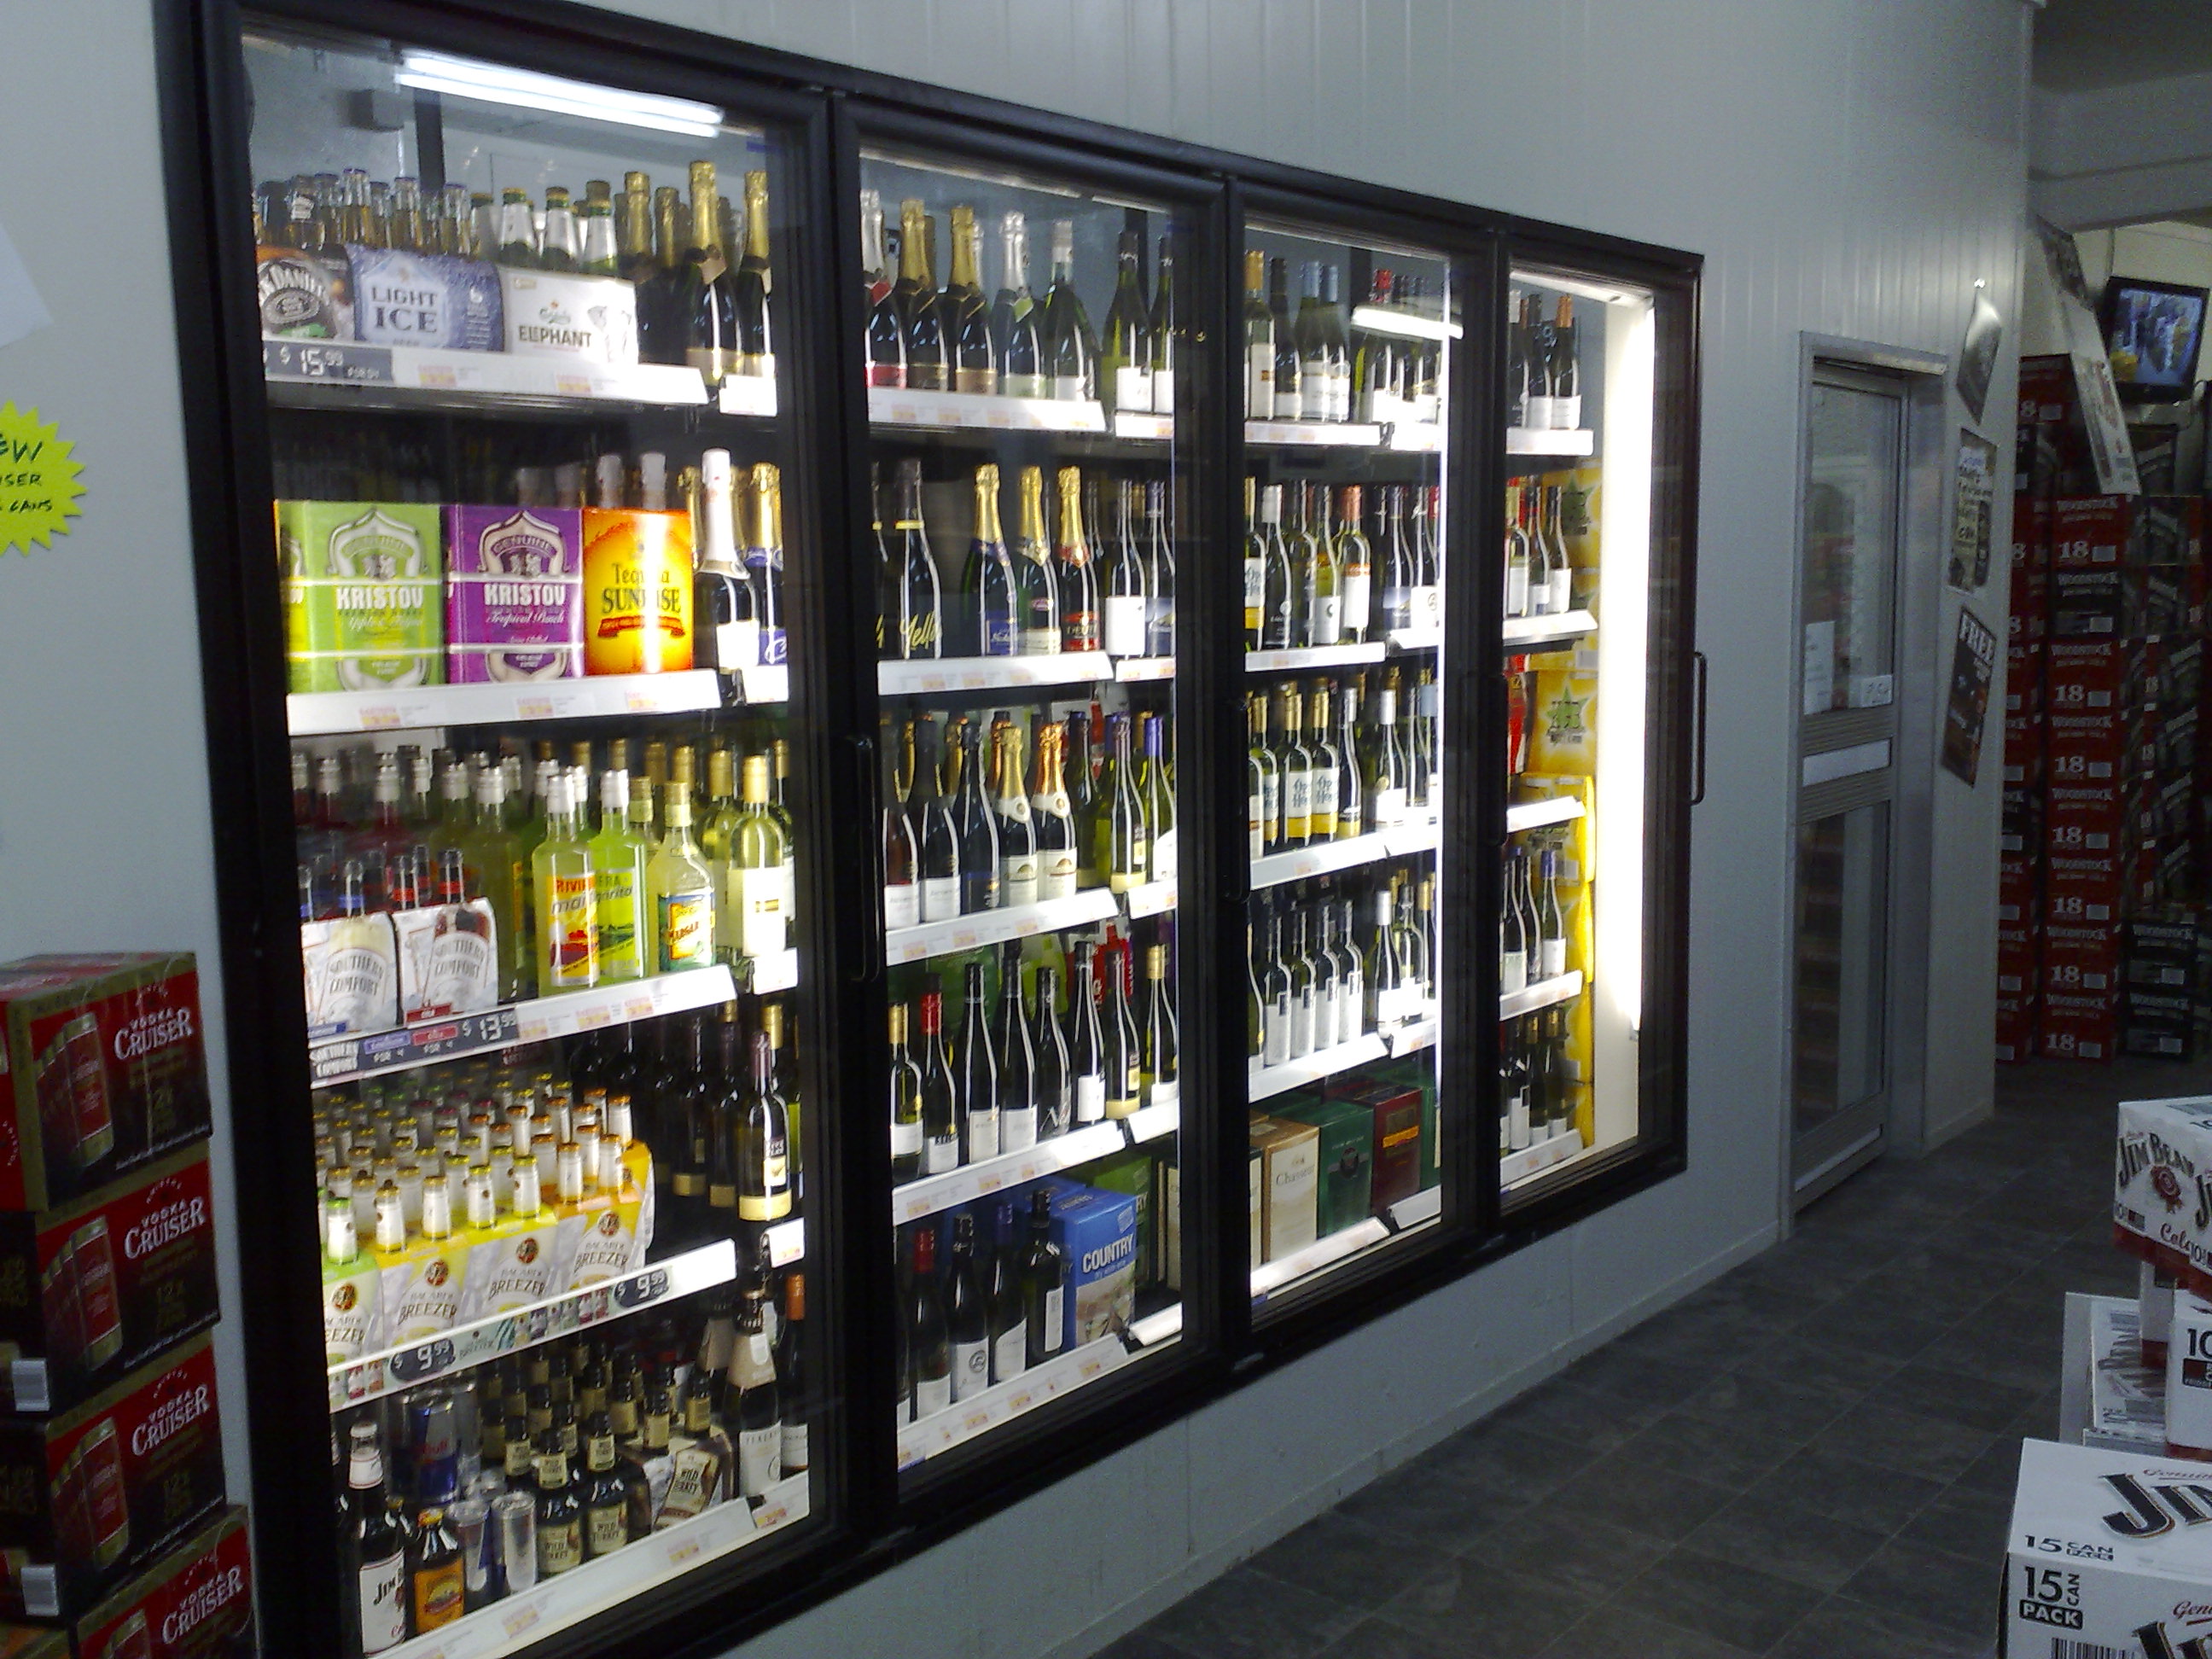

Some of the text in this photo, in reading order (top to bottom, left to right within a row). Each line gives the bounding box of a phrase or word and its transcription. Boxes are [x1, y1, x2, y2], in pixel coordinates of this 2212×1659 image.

[371, 286, 438, 306] LIGHT
[375, 307, 438, 333] ICE
[519, 325, 591, 347] ELEPHANT
[0, 434, 43, 463] EW
[2059, 541, 2089, 559] 18
[336, 587, 424, 609] KRISTOV
[484, 584, 566, 606] KRISTOV
[602, 587, 681, 614] SUNISE
[2056, 684, 2085, 702] 18
[2055, 755, 2085, 773] 18
[2052, 825, 2082, 844] 18
[2055, 896, 2082, 914] 18
[2052, 965, 2080, 982] 18
[130, 1008, 172, 1029] VODKA
[114, 1007, 193, 1060] CRUISER
[2048, 1033, 2076, 1051] 18
[2119, 1132, 2194, 1188] JIM BEAM
[142, 1199, 187, 1227] VODKA
[125, 1196, 207, 1260] CRUISER
[573, 1250, 629, 1275] BREEZER
[1082, 1233, 1134, 1273] COUNTRY
[487, 1278, 546, 1301] BREEZER
[398, 1302, 458, 1326] BREEZER
[148, 1388, 191, 1423] VODKA
[132, 1383, 211, 1456] CRUISER
[2025, 1535, 2114, 1553] 15 CAN
[179, 1571, 224, 1608] VODKA
[2025, 1566, 2080, 1606] 15 CAN
[162, 1564, 243, 1644] CRUISER
[2023, 1603, 2081, 1627] PACK
